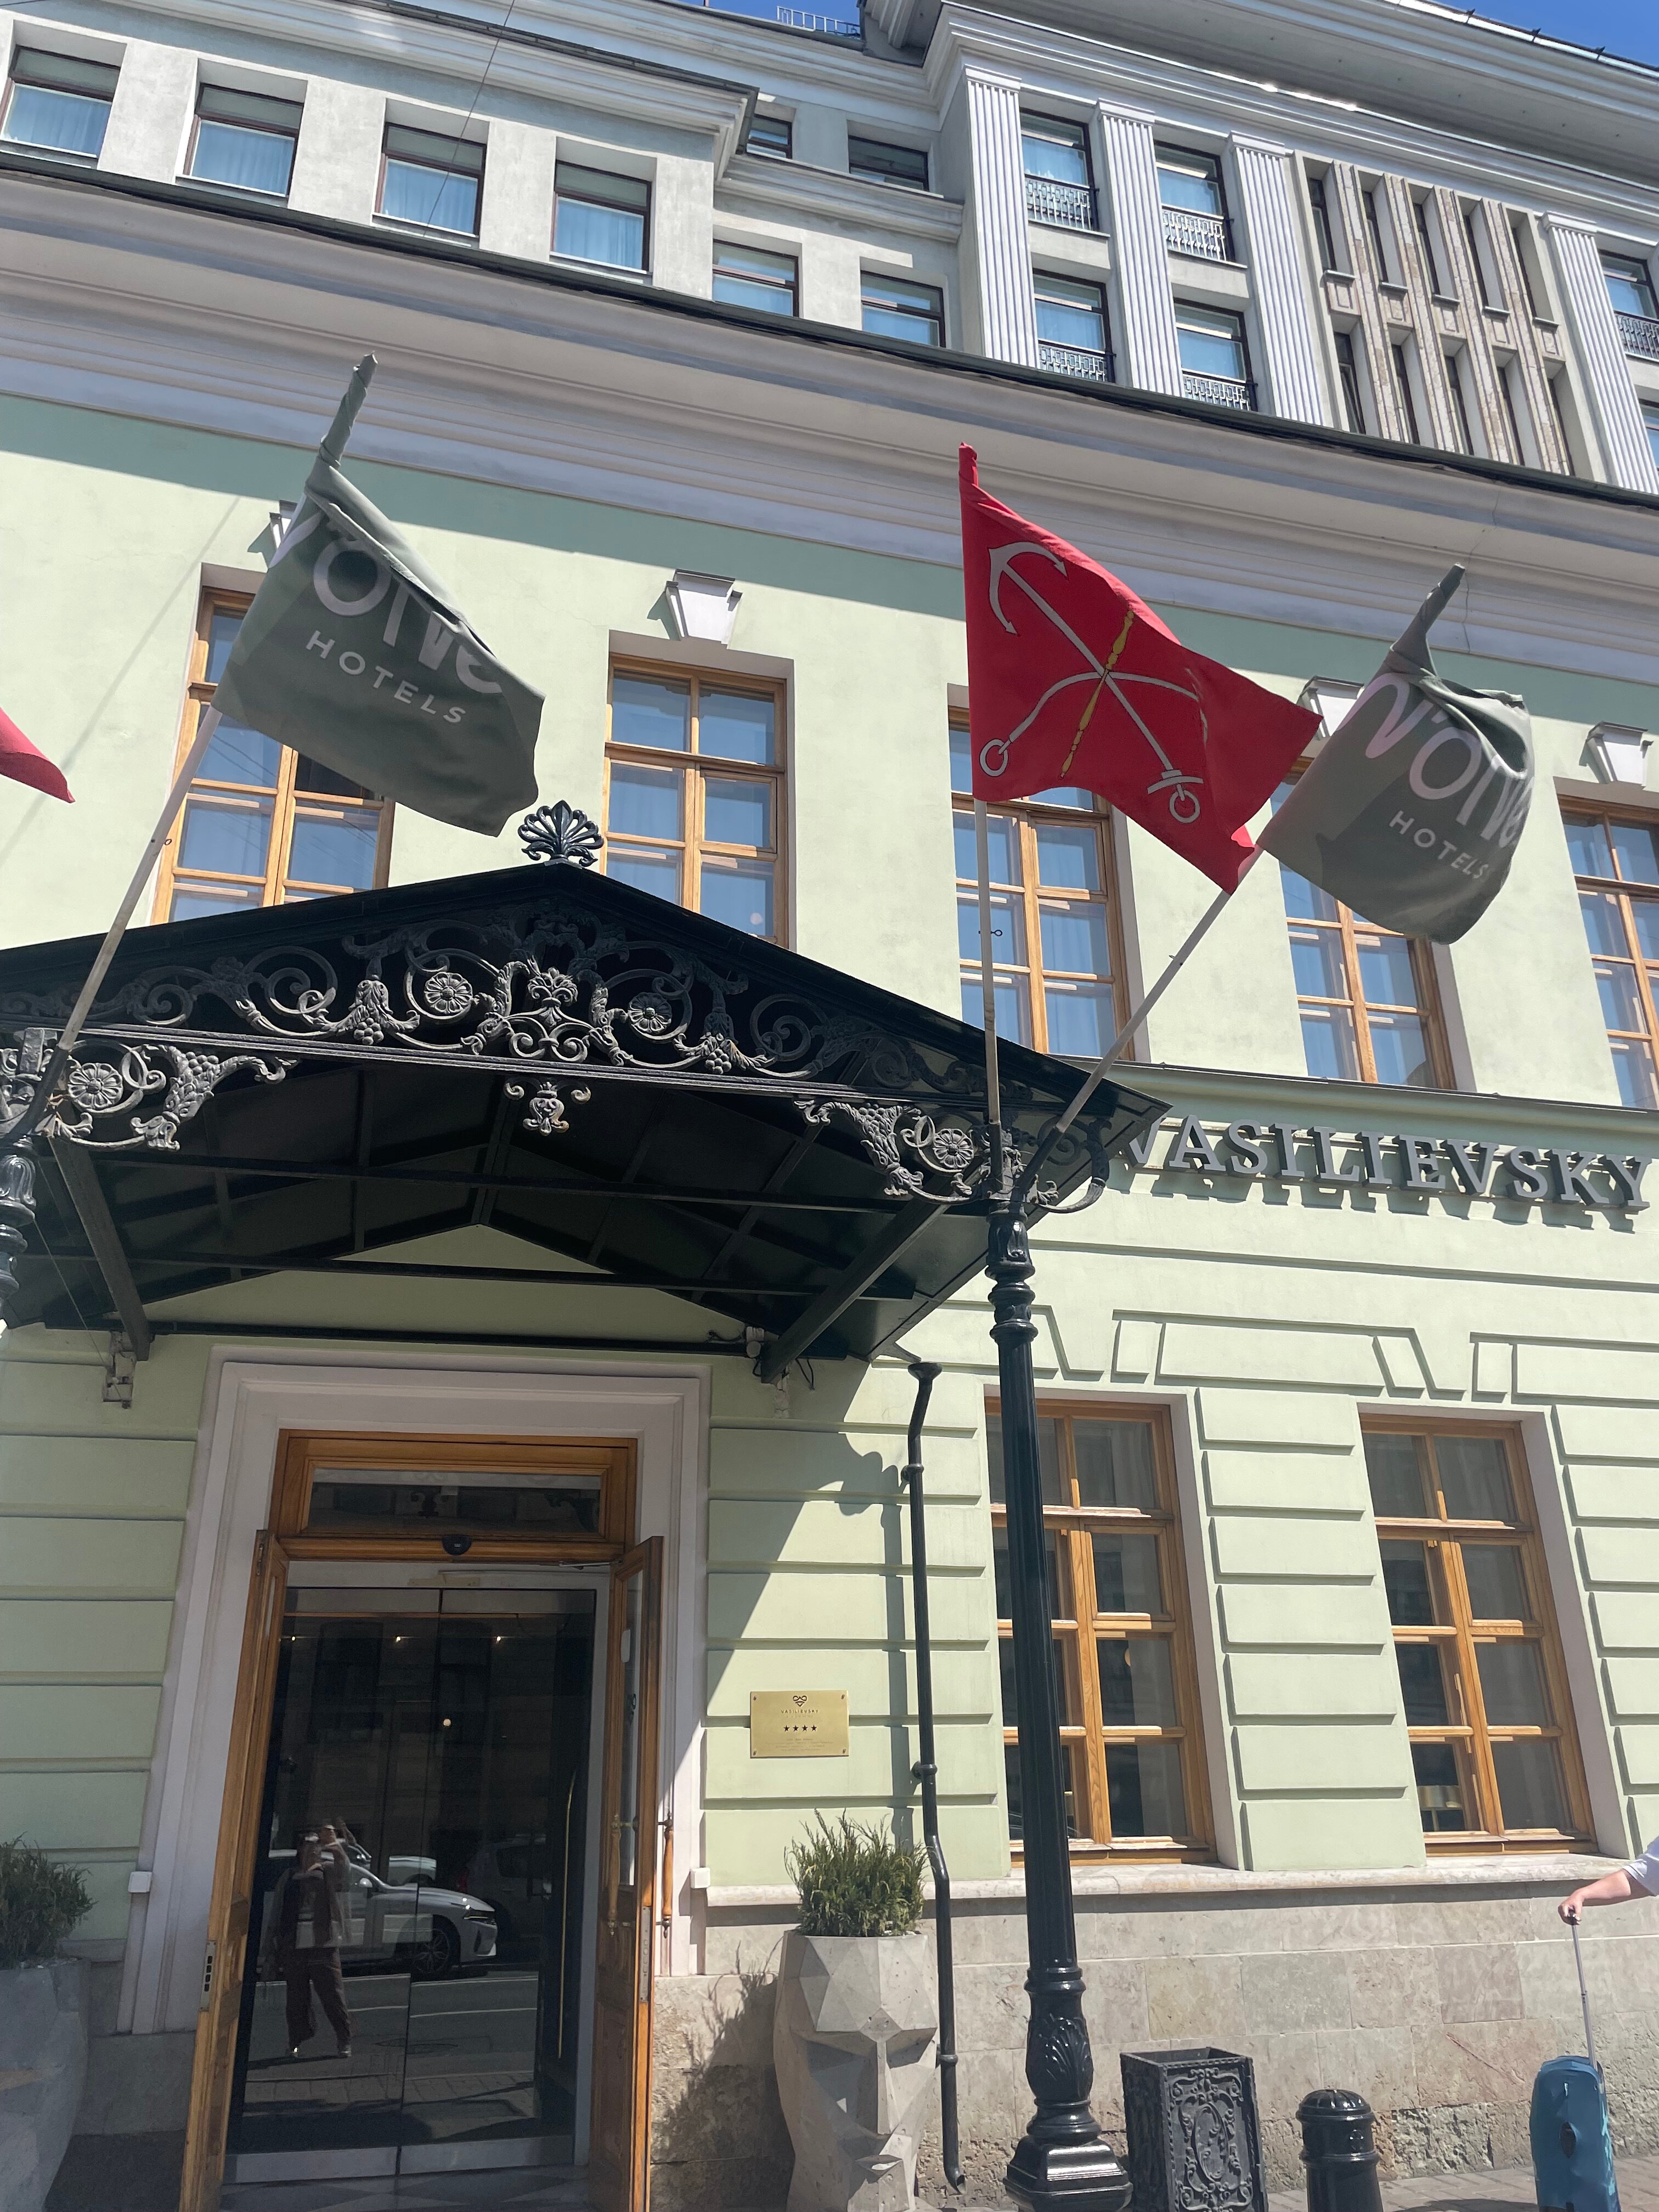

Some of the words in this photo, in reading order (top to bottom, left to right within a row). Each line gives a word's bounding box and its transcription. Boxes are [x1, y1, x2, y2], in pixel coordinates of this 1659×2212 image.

[306, 630, 466, 723] HOTELS
[1389, 810, 1489, 879] HOTELS
[1127, 1114, 1652, 1210] VASILIEVSKY
